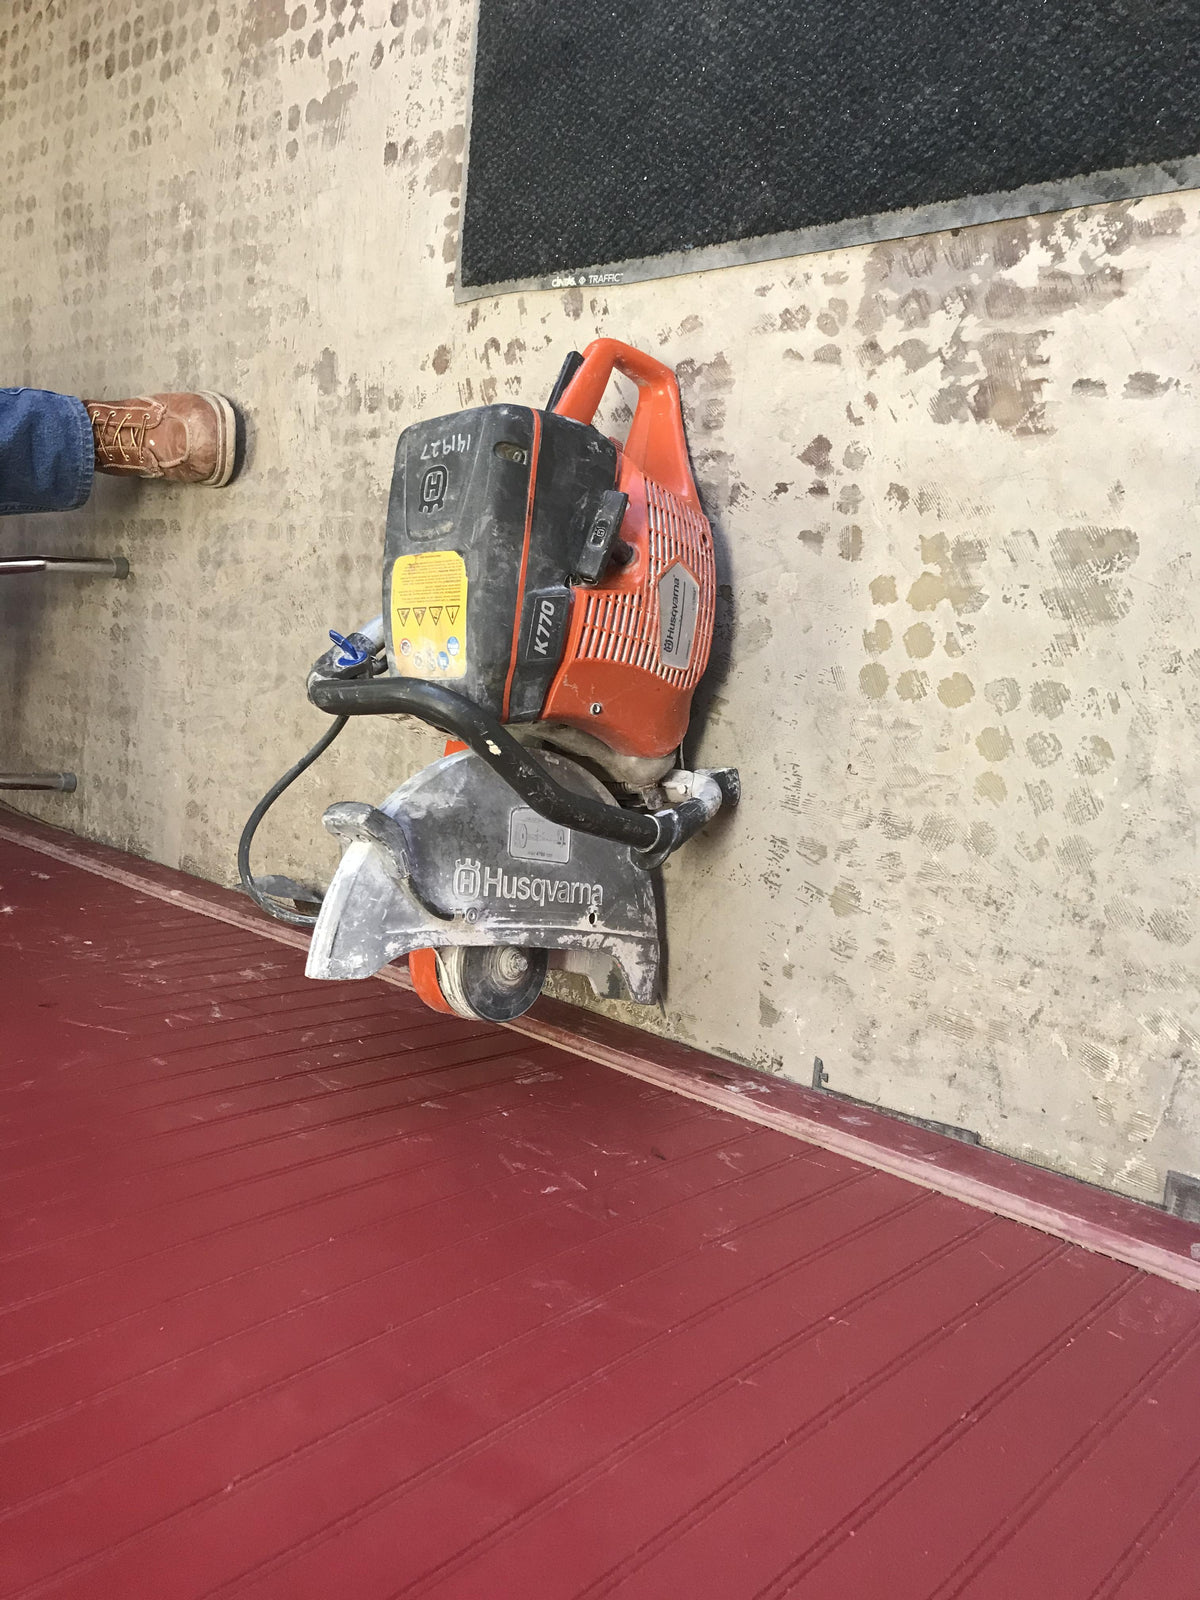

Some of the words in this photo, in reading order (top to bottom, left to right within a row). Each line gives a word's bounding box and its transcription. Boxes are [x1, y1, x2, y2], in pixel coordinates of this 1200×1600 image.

[588, 273, 621, 284] TRAFFIC
[420, 433, 471, 460] 141927
[533, 600, 555, 655] K770
[667, 577, 680, 640] Husqvarna
[482, 866, 604, 907] Husqvarna
